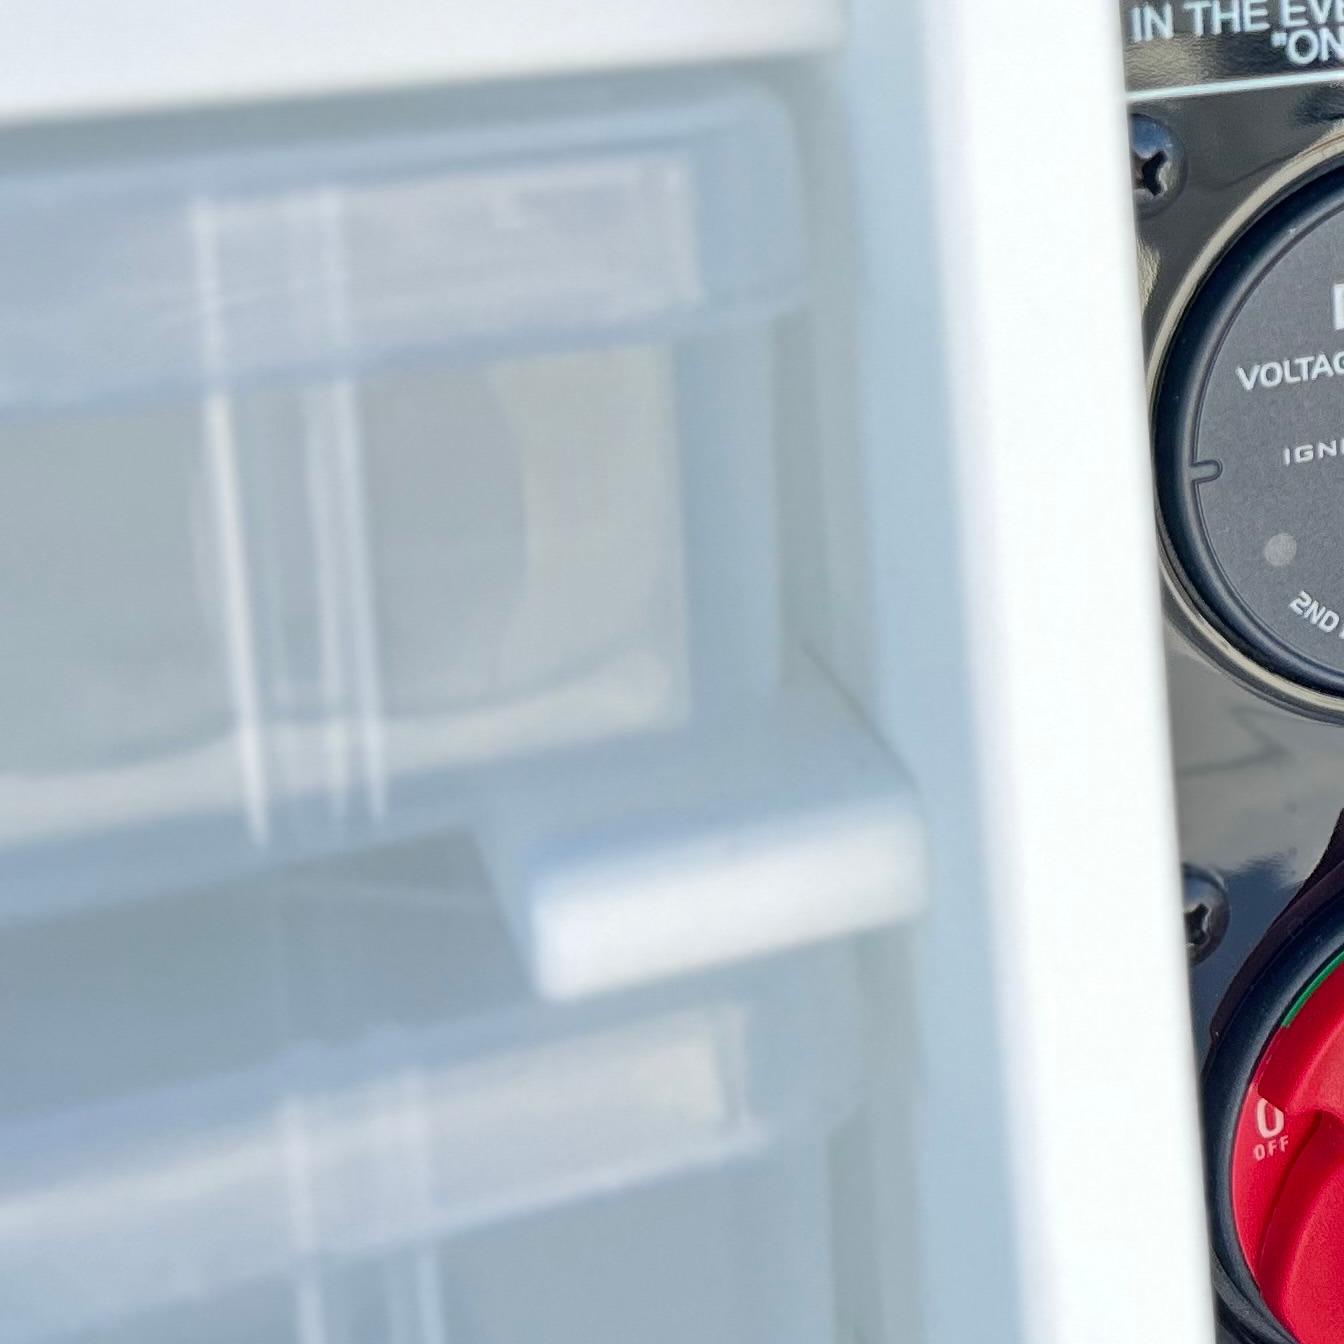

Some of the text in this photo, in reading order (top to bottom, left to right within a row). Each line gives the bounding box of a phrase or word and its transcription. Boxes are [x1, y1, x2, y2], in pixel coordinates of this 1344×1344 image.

[1131, 5, 1173, 43] IN
[1289, 590, 1340, 633] 2ND
[1254, 1135, 1288, 1161] OFF
